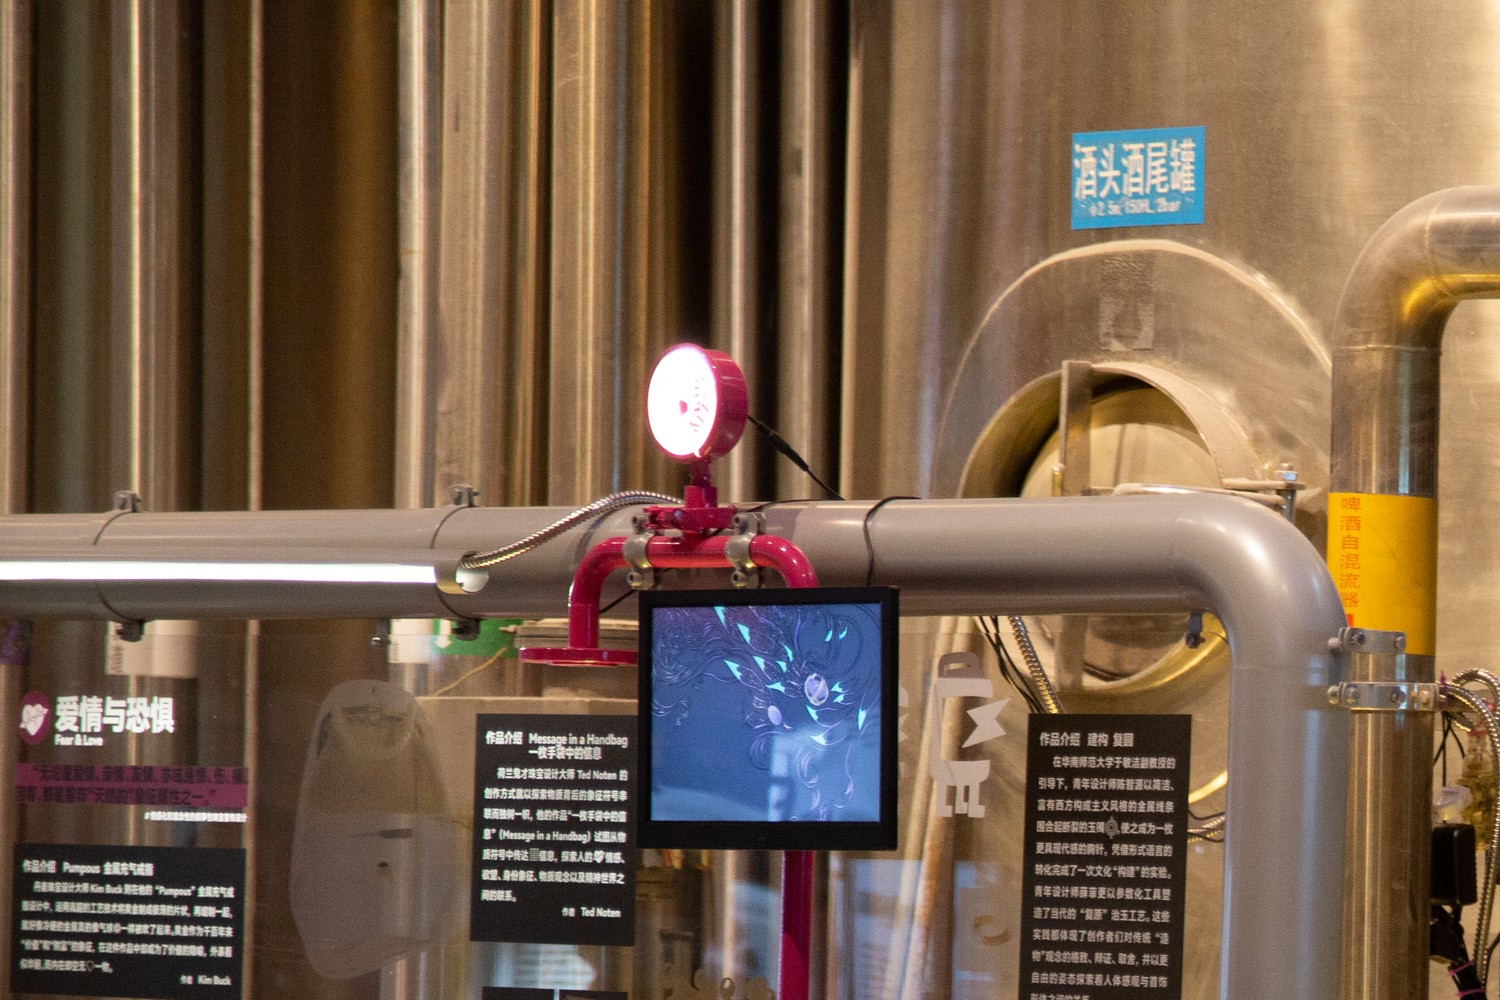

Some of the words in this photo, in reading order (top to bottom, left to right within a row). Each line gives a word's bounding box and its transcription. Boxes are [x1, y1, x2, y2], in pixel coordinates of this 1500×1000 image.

[1074, 139, 1196, 199] 酒头酒尾罐
[55, 696, 174, 733] 爱情与恐惧
[55, 734, 73, 745] Fear
[75, 734, 82, 746] &
[83, 734, 103, 746] Love
[485, 731, 523, 745] 作品介绍
[528, 732, 566, 748] Message
[568, 733, 578, 745] in
[587, 733, 628, 748] Handbag
[1039, 732, 1080, 747] 作品介绍
[1087, 733, 1108, 747] 建构
[528, 747, 602, 760] 一枚手袋中的信息
[577, 769, 591, 780] Ted
[593, 769, 617, 781] Noten
[619, 769, 628, 781] 的
[537, 831, 544, 841] in
[22, 860, 57, 873] 作品介绍
[90, 884, 104, 893] Kim
[106, 883, 123, 894] Buck
[562, 907, 575, 917] 作者
[581, 907, 595, 918] Ted
[597, 907, 621, 918] Noten
[197, 975, 212, 985] Kim
[213, 975, 232, 986] Buck
